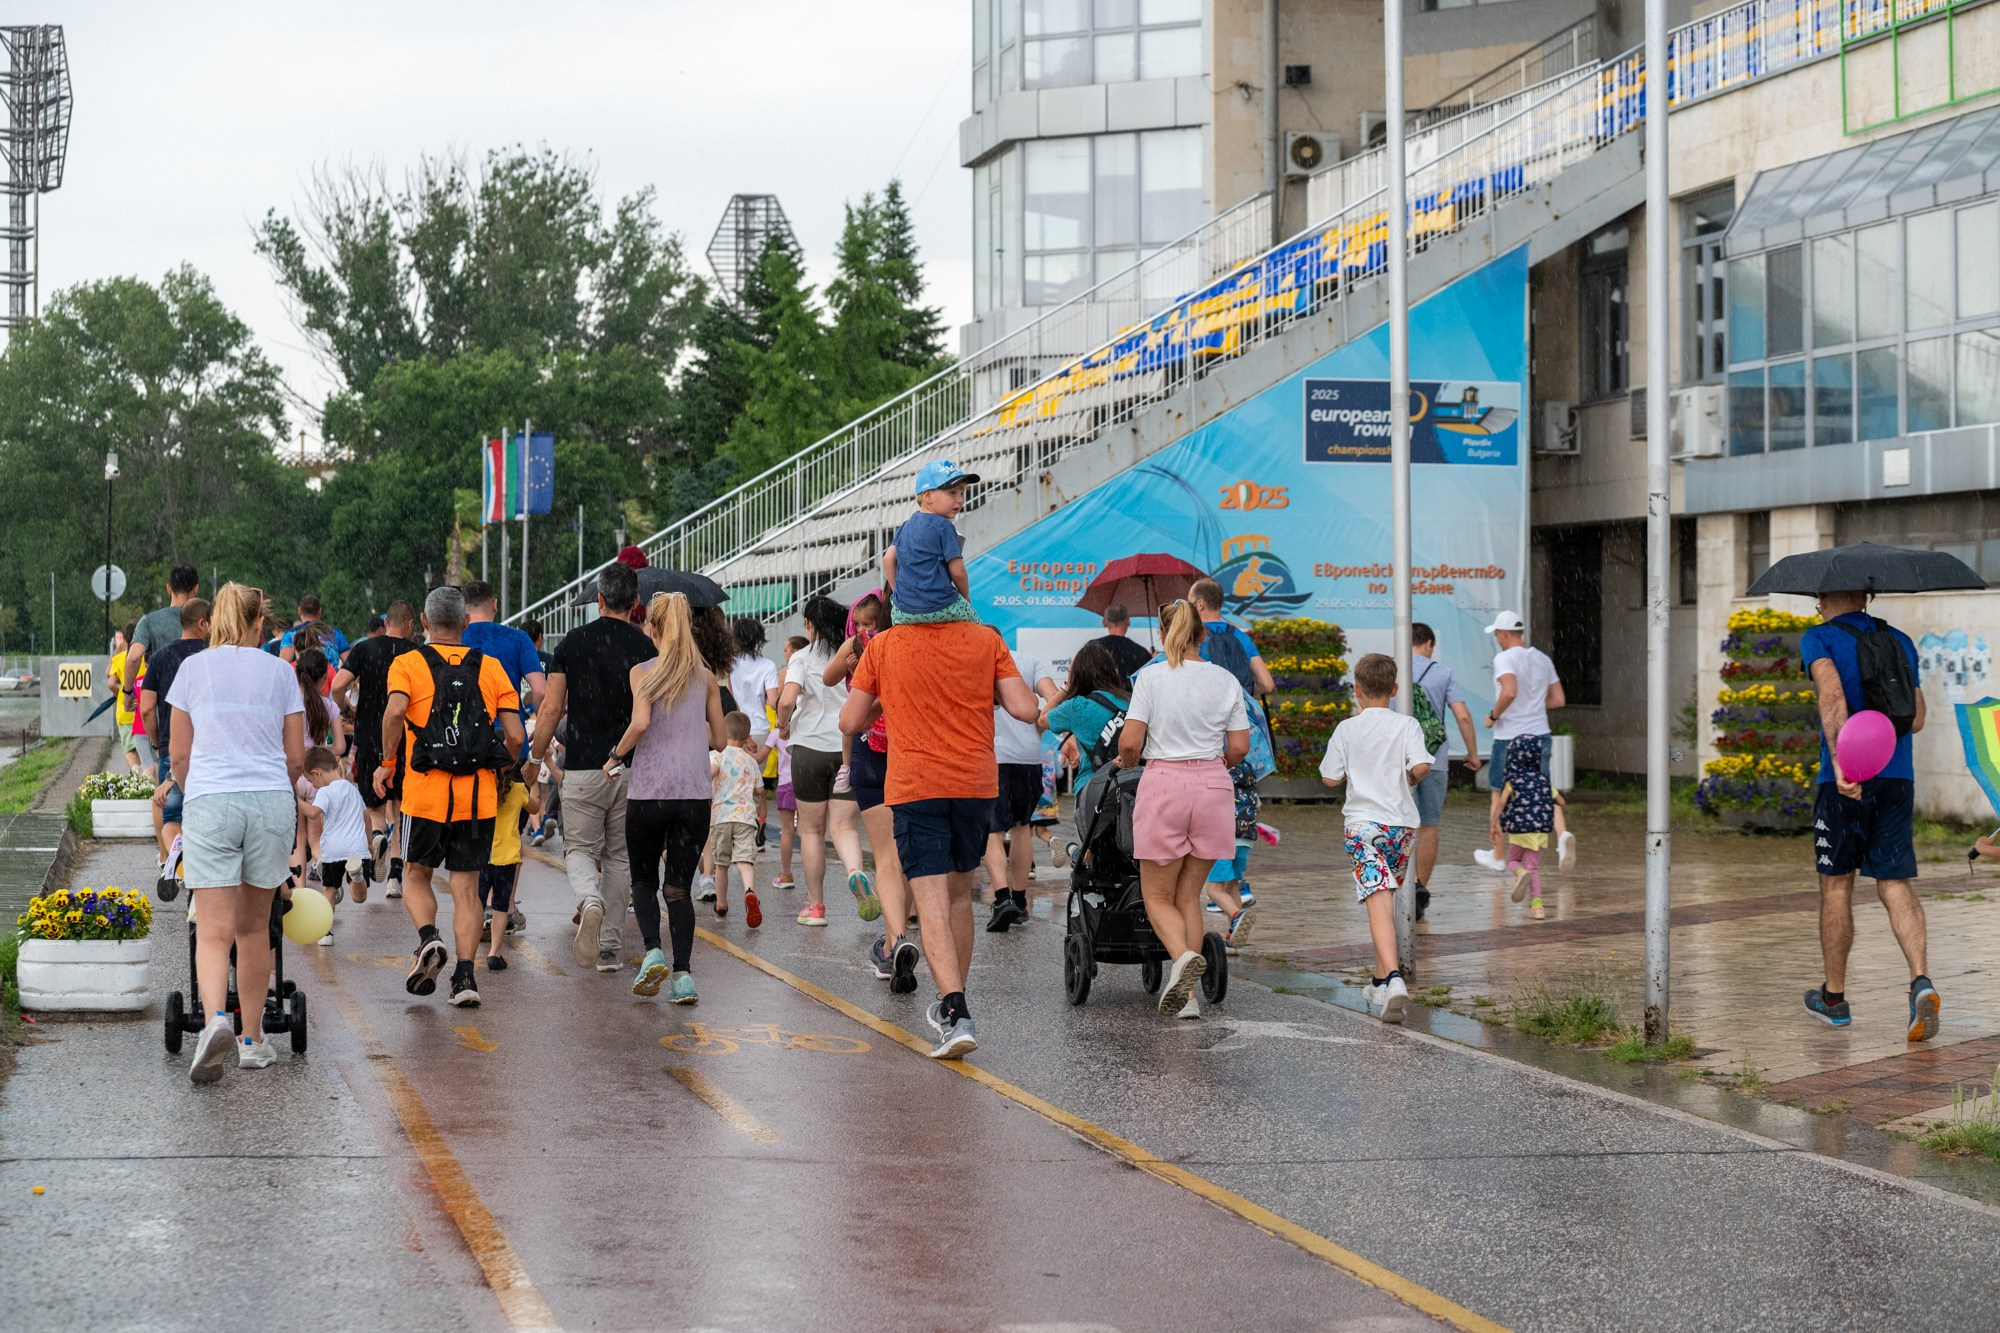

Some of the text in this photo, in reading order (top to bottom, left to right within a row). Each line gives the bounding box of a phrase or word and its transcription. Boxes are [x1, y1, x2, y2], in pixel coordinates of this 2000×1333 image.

[1311, 389, 1339, 400] 2025
[1310, 408, 1392, 427] european
[1353, 423, 1414, 440] rowi
[1327, 445, 1392, 457] championsh
[1467, 448, 1501, 459] Bulgaria
[1218, 480, 1289, 511] 2025
[1008, 560, 1097, 577] European
[1313, 563, 1505, 581] Европейск първенство
[1020, 576, 1089, 593] Champi
[1367, 582, 1387, 594] по
[1052, 657, 1072, 666] worl
[60, 669, 91, 690] 2000
